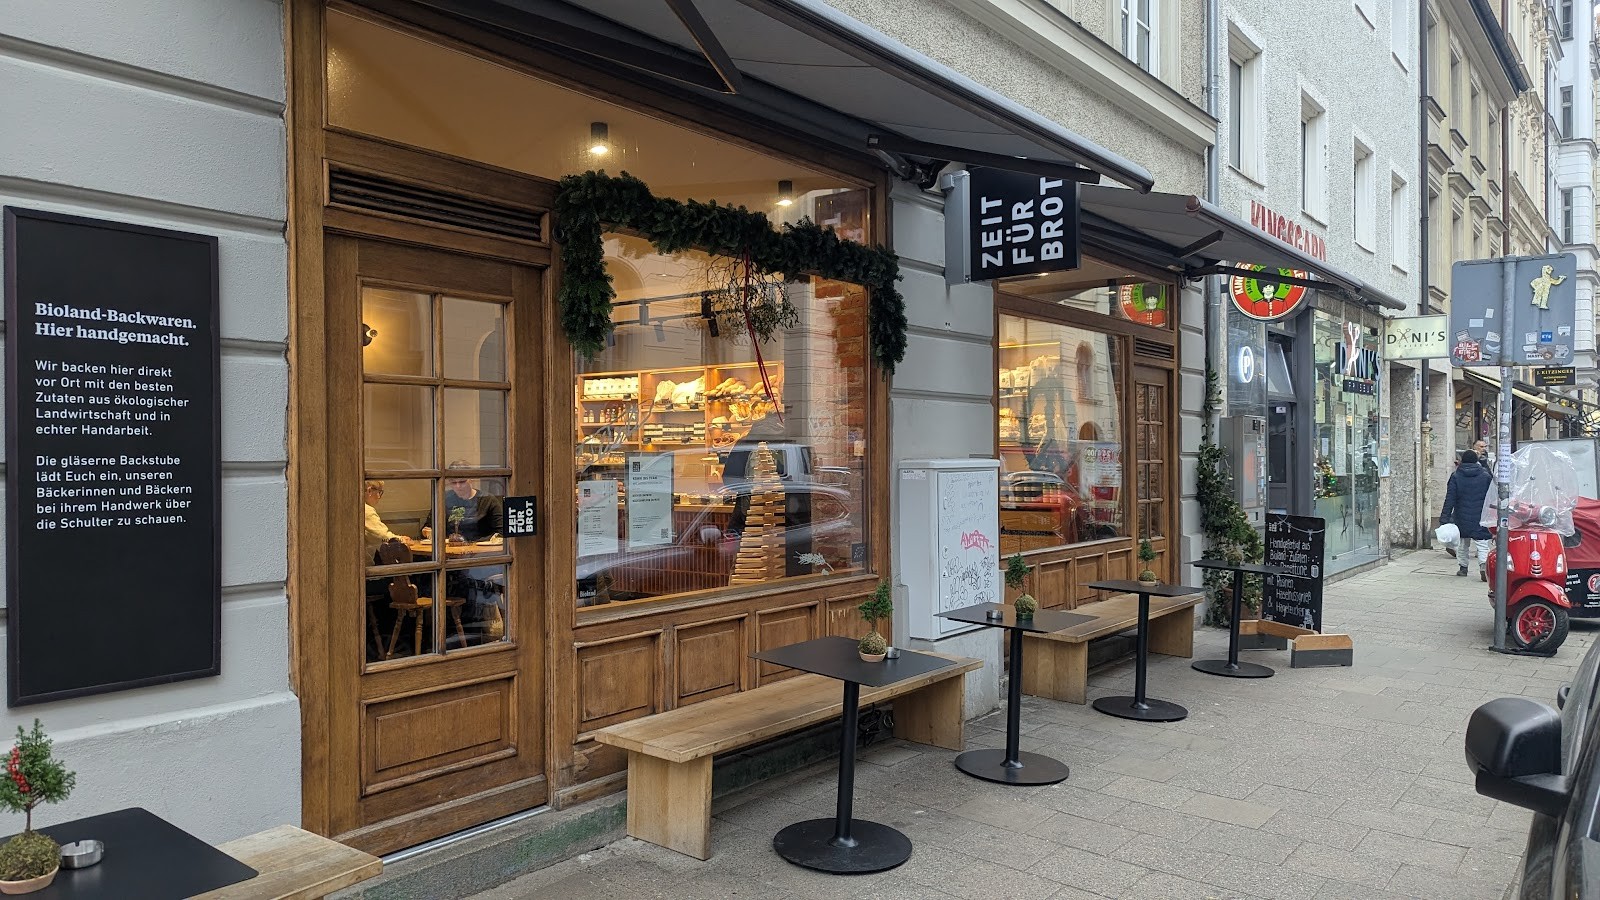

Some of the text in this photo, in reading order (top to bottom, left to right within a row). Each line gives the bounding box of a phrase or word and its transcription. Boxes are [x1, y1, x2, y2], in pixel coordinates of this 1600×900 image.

[1040, 177, 1064, 261] BROT
[981, 196, 1003, 269] ZEIT
[1006, 199, 1034, 265] FÜR
[35, 302, 197, 329] Bioland-Backwaren.
[35, 322, 190, 346] Hier handgemacht.
[35, 359, 172, 378] Wir backen hier direkt
[35, 377, 173, 392] vor Ort mit den besten
[35, 391, 190, 408] Zutaten aus ökologischer
[36, 407, 171, 421] Landwirtschaft und in
[35, 424, 152, 436] echter Handarbeit.
[36, 455, 181, 468] Die gläserne Backstube
[36, 471, 173, 482] lädt Euch ein, unseren
[36, 484, 192, 498] Bäckerinnen und Bäckern
[36, 499, 192, 514] bei ihrem Handwerk über
[36, 515, 187, 530] die Schulter zu schauen.
[508, 506, 517, 534] ZEIT
[516, 510, 525, 533] FÜR
[525, 500, 534, 533] BROT
[1301, 542, 1310, 550] aus
